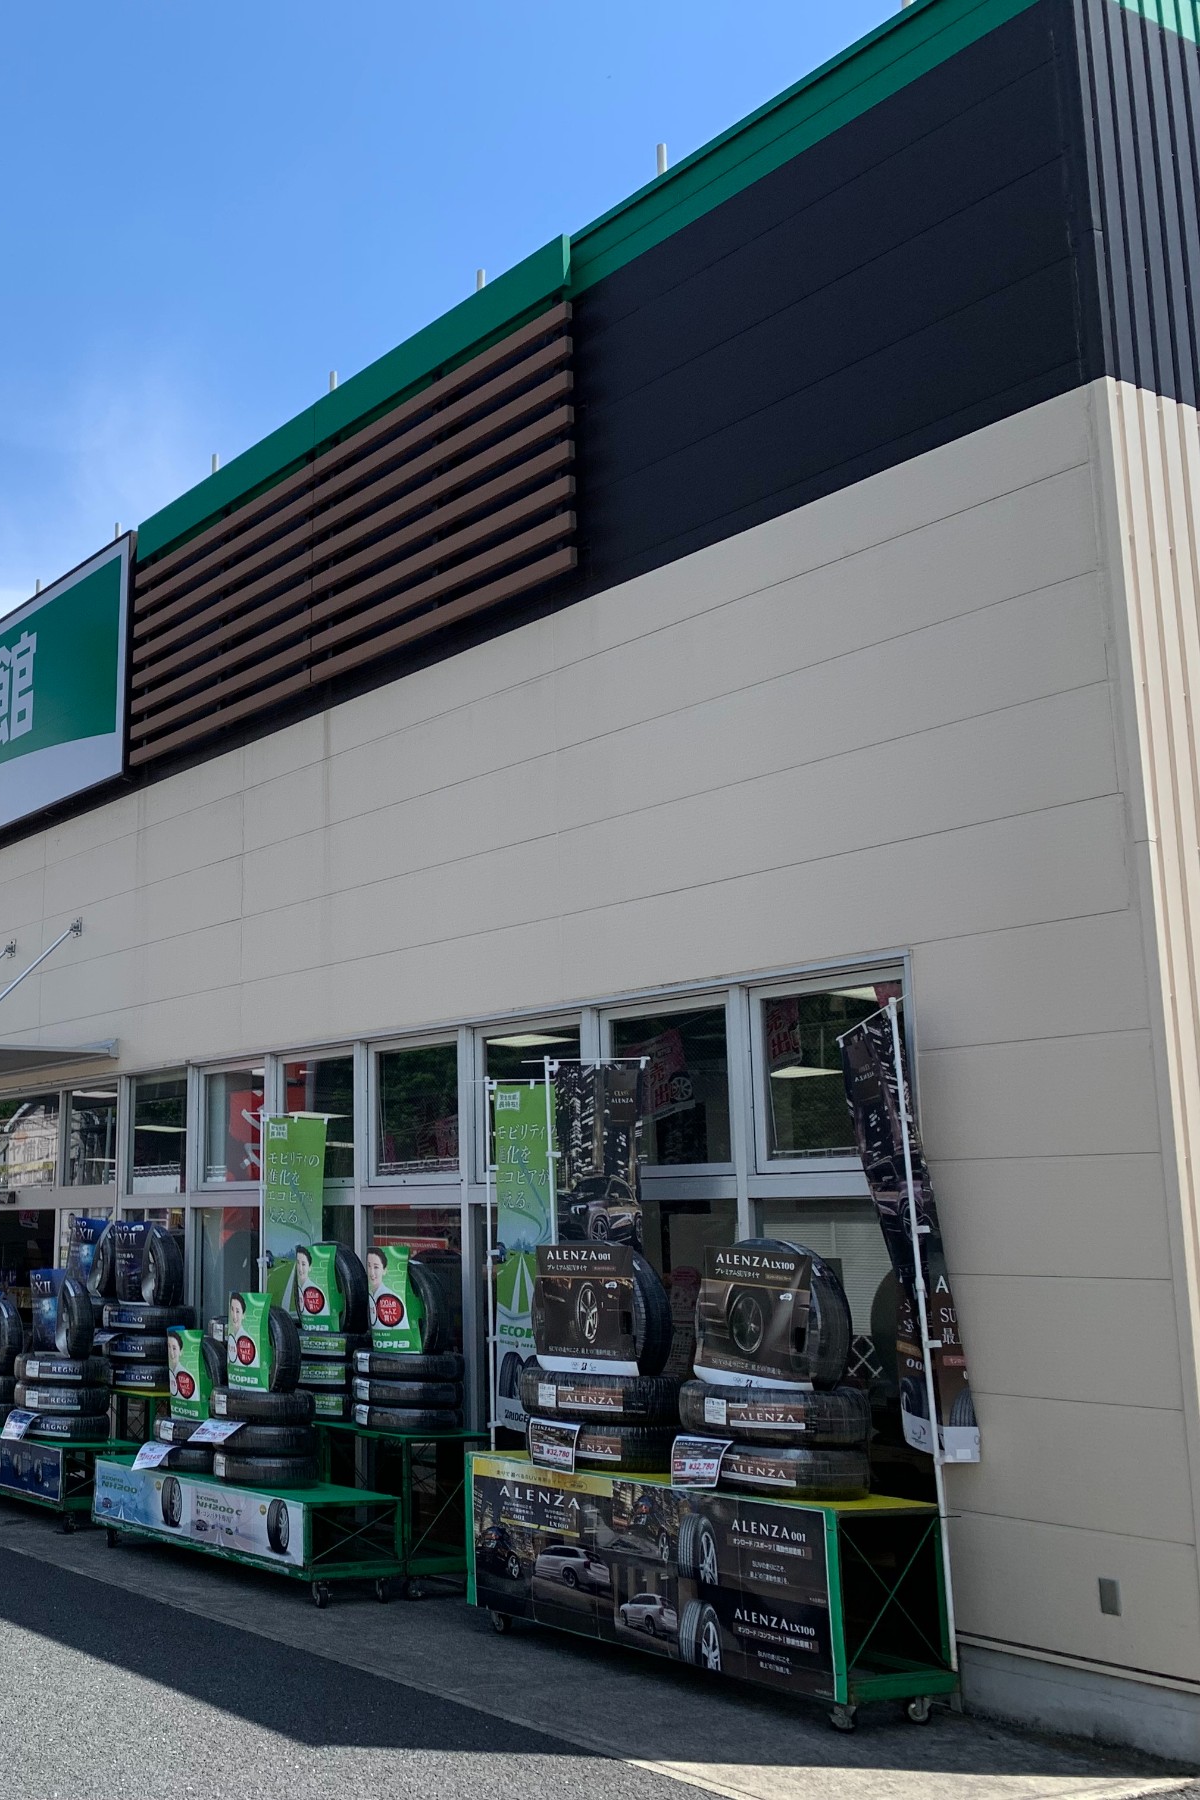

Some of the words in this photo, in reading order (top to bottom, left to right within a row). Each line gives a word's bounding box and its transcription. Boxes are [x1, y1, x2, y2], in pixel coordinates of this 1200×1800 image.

[268, 1152, 320, 1167] モビリティの
[268, 1168, 300, 1186] 進化を
[52, 1366, 81, 1374] REGNO
[50, 1396, 79, 1404] REGNO
[566, 1394, 615, 1406] ALENZA
[739, 1412, 796, 1423] ALENZA
[40, 1422, 69, 1431] REGNO
[546, 1447, 570, 1459] ¥32,780
[688, 1462, 715, 1471] ¥32,780
[730, 1463, 787, 1479] ALENZA
[101, 1480, 138, 1494] NH200
[499, 1485, 581, 1510] ALENZA
[196, 1501, 234, 1514] NH200
[549, 1520, 570, 1530] LX100
